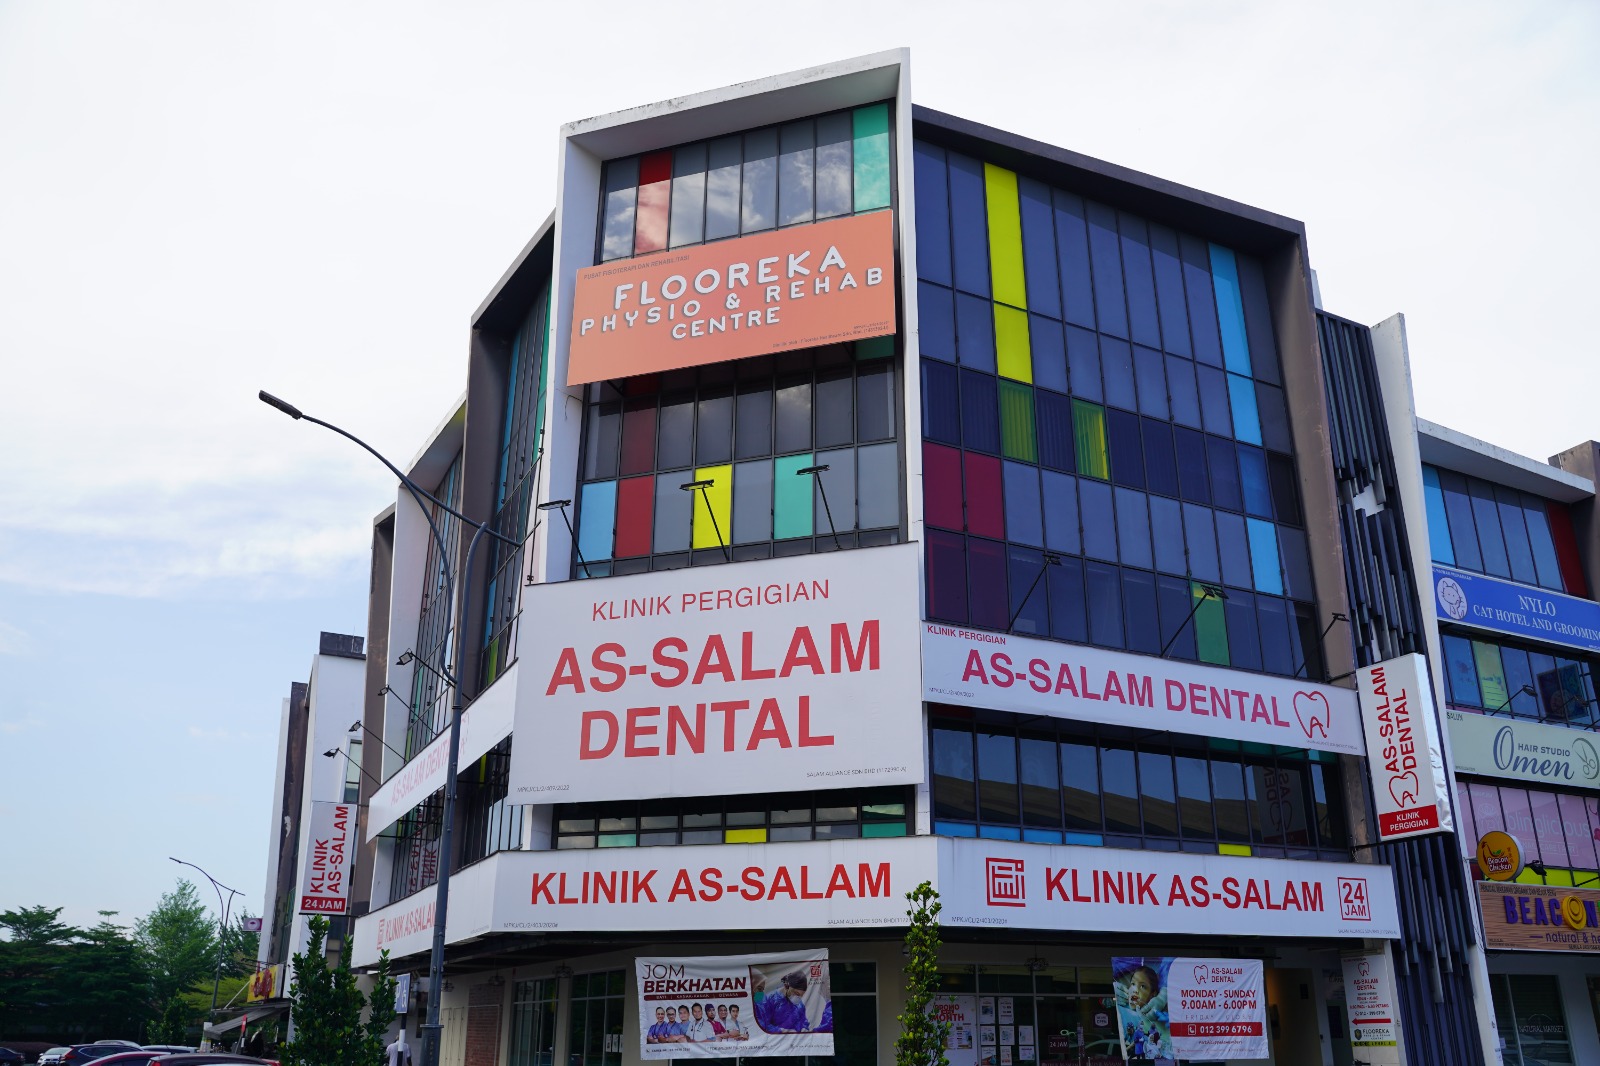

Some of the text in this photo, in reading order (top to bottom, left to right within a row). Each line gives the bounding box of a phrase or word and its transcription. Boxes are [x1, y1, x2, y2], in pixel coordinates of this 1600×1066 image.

[614, 245, 846, 310] FLOOREKA
[581, 267, 883, 336] PHYSIO & REHAB
[672, 306, 780, 339] CENTRE
[592, 579, 829, 621] KLINIK PERGIGIAN
[1518, 595, 1556, 617] NYLO
[1473, 604, 1494, 619] CAT
[1495, 609, 1530, 627] HOTEL
[1532, 617, 1552, 632] AND
[927, 625, 1006, 645] KLINIK PERGIGIAN
[546, 619, 881, 696] AS-SALAM
[962, 650, 1290, 728] AS-SALAM DENTAL
[579, 695, 835, 760] DENTAL
[1371, 667, 1400, 773] AS-SALAM
[1393, 688, 1418, 770] DENTAL
[1518, 743, 1571, 757] HAIR STUDIO
[1389, 819, 1429, 832] PERGIGIAN
[1396, 811, 1420, 822] KLINIK
[327, 806, 349, 894] AS-SALAM
[310, 838, 329, 894] KLINIK
[1487, 857, 1509, 865] Beacon
[1489, 863, 1512, 872] Chicken
[531, 862, 891, 905] KLINIK AS-SALAM
[1046, 868, 1325, 912] KLINIK AS-SALAM
[1343, 882, 1365, 905] 24
[305, 899, 343, 910] 24 JAM
[1344, 904, 1367, 919] JAM
[1546, 931, 1579, 943] natural
[1582, 932, 1588, 943] &
[642, 964, 685, 979] JOM
[1211, 967, 1243, 975] AS-SALAM
[1211, 975, 1235, 983] DENTAL
[644, 977, 747, 993] BERKHATAN
[1181, 989, 1218, 998] MONDAY
[1223, 990, 1256, 998] SUNDAY
[1181, 1000, 1216, 1010] 9.00AM
[1223, 1000, 1257, 1010] 6.00PM
[1200, 1026, 1214, 1034] 012
[1231, 1025, 1252, 1033] 6796
[1518, 1025, 1564, 1033] NATURAL MARKET
